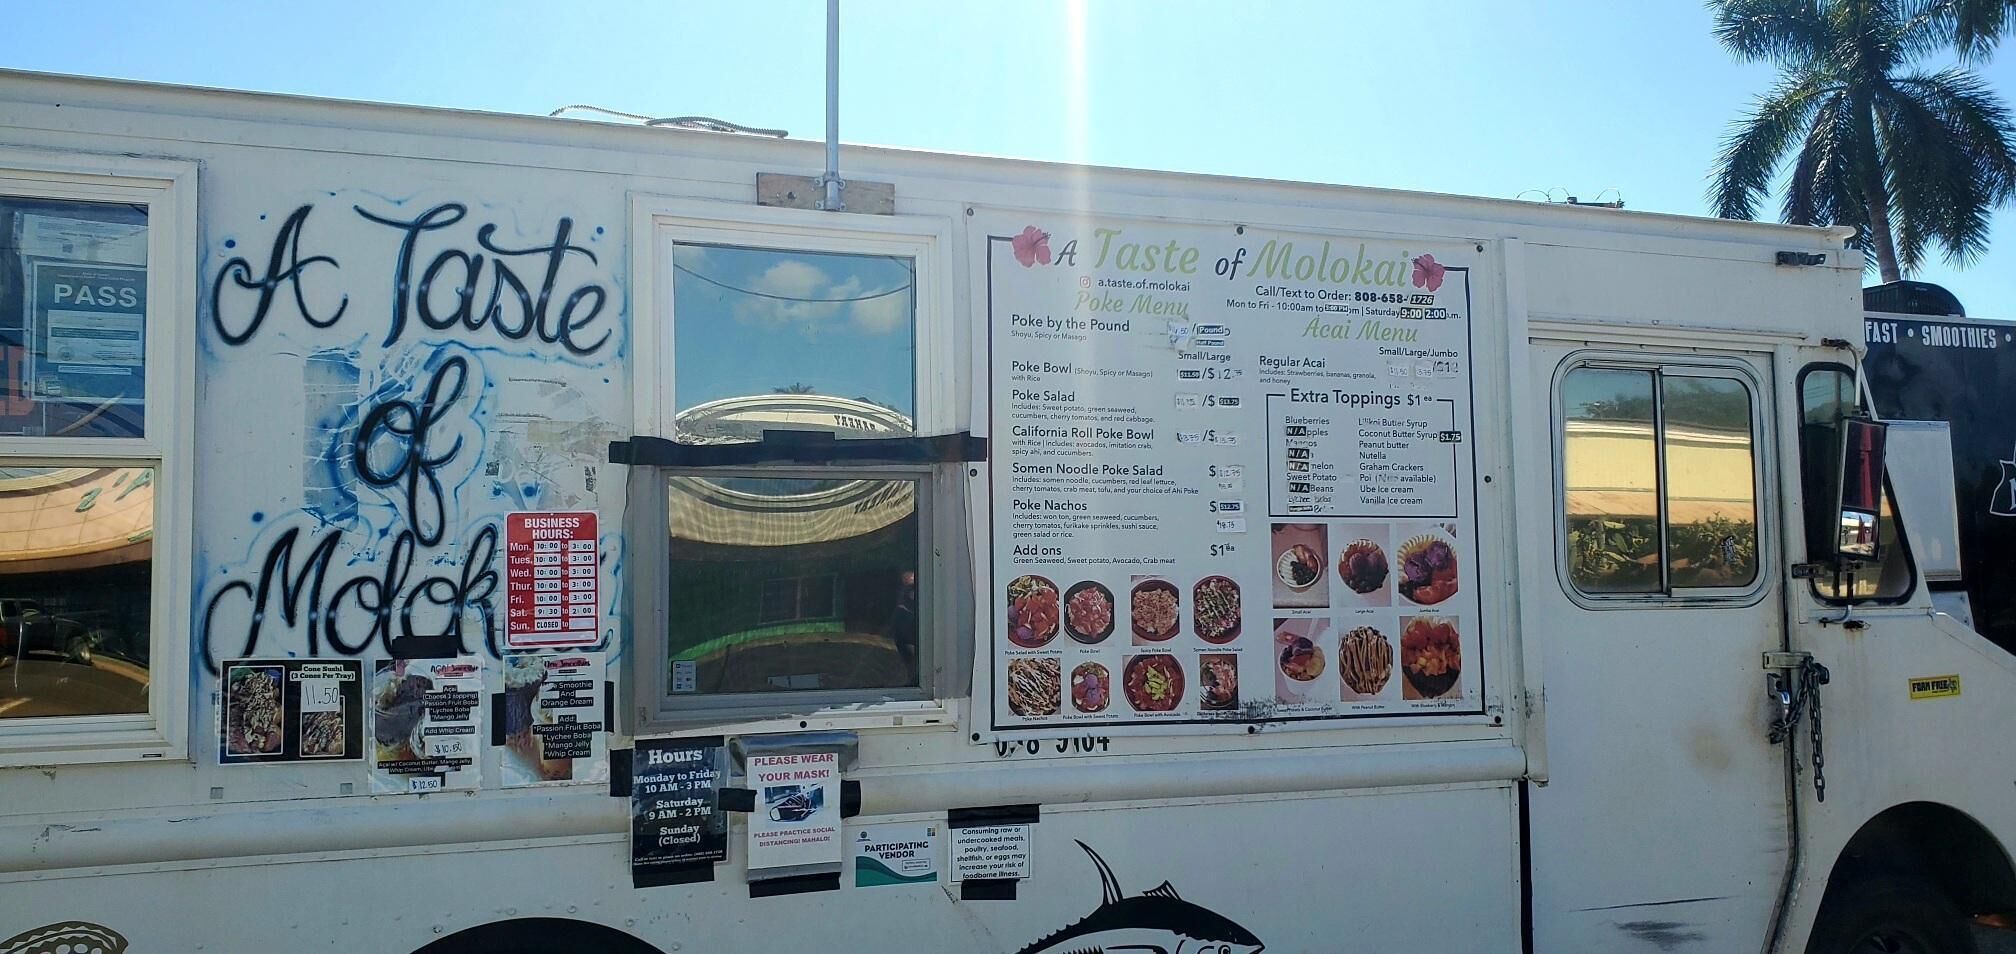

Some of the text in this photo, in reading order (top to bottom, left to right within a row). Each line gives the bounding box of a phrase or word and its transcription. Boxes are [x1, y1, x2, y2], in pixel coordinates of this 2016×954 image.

[1054, 228, 1409, 287] A Taste of Molokai
[211, 201, 612, 356] A Taste
[1098, 278, 1190, 291] a.taste.of.molokai
[54, 284, 137, 307] PASS
[1256, 286, 1302, 298] Call/Text
[1305, 290, 1315, 298] to
[1318, 289, 1352, 300] Order:
[1411, 295, 1433, 304] 1726
[1075, 291, 1189, 316] Poke Menu
[1227, 299, 1245, 308] Mon
[1259, 301, 1269, 309] Fri
[1366, 307, 1400, 317] Saturday
[1401, 309, 1422, 317] 9:00
[1426, 309, 1445, 318] 2:00
[1012, 315, 1130, 332] Poke by the Pound
[1303, 317, 1417, 342] Acai Menu
[1922, 325, 1997, 348] SMOOTHIES
[1178, 352, 1231, 363] Small/Large
[1379, 347, 1458, 358] Small/Large/Jumbo
[1012, 361, 1072, 374] Poke Bowl
[1259, 356, 1325, 368] Regular Acai
[1012, 390, 1075, 402] Poke Salad
[1291, 389, 1329, 403] Extra
[1333, 390, 1400, 408] Toppings
[1286, 416, 1329, 424] Blueberries
[1012, 426, 1154, 440] California Roll Poke Bowl
[1359, 429, 1437, 440] Coconut Butter Syrup
[354, 356, 468, 547] of
[1289, 449, 1308, 458] N/A
[1012, 463, 1162, 476] Somen Noodle Poke Salad
[1392, 463, 1423, 471] Crackers
[1313, 473, 1337, 481] Potato
[1360, 485, 1375, 493] Ube
[1013, 500, 1087, 511] Poke Nachos
[1360, 496, 1385, 504] Vanilla
[525, 518, 580, 528] BUSINESS
[533, 529, 573, 539] HOURS:
[510, 543, 531, 551] Mon.
[1013, 545, 1061, 556] Add ons
[510, 556, 532, 564] Tues.
[511, 569, 531, 577] Wed.
[511, 582, 532, 590] Thur.
[204, 524, 502, 678] Molok
[511, 596, 524, 604] Fri.
[511, 609, 527, 617] Sat.
[510, 622, 530, 630] Sun.
[305, 684, 338, 705] 11.50
[648, 749, 702, 764] Hours
[754, 754, 833, 766] PLEASE WEAR
[634, 774, 675, 784] Monday
[690, 769, 721, 780] Friday
[759, 770, 829, 782] YOUR MASK!
[645, 785, 656, 793] 10
[660, 783, 678, 792] AM
[695, 780, 711, 789] PM
[656, 798, 704, 809] Saturday
[649, 812, 655, 820] 9
[658, 810, 677, 819] AM
[694, 807, 711, 816] PM
[660, 825, 700, 835] Sunday
[754, 830, 778, 838] PLEASE
[780, 828, 810, 836] PRACTICE
[659, 834, 701, 847] (Closed)
[865, 841, 928, 852] PARTICIPATING
[880, 850, 914, 859] VENDOR
